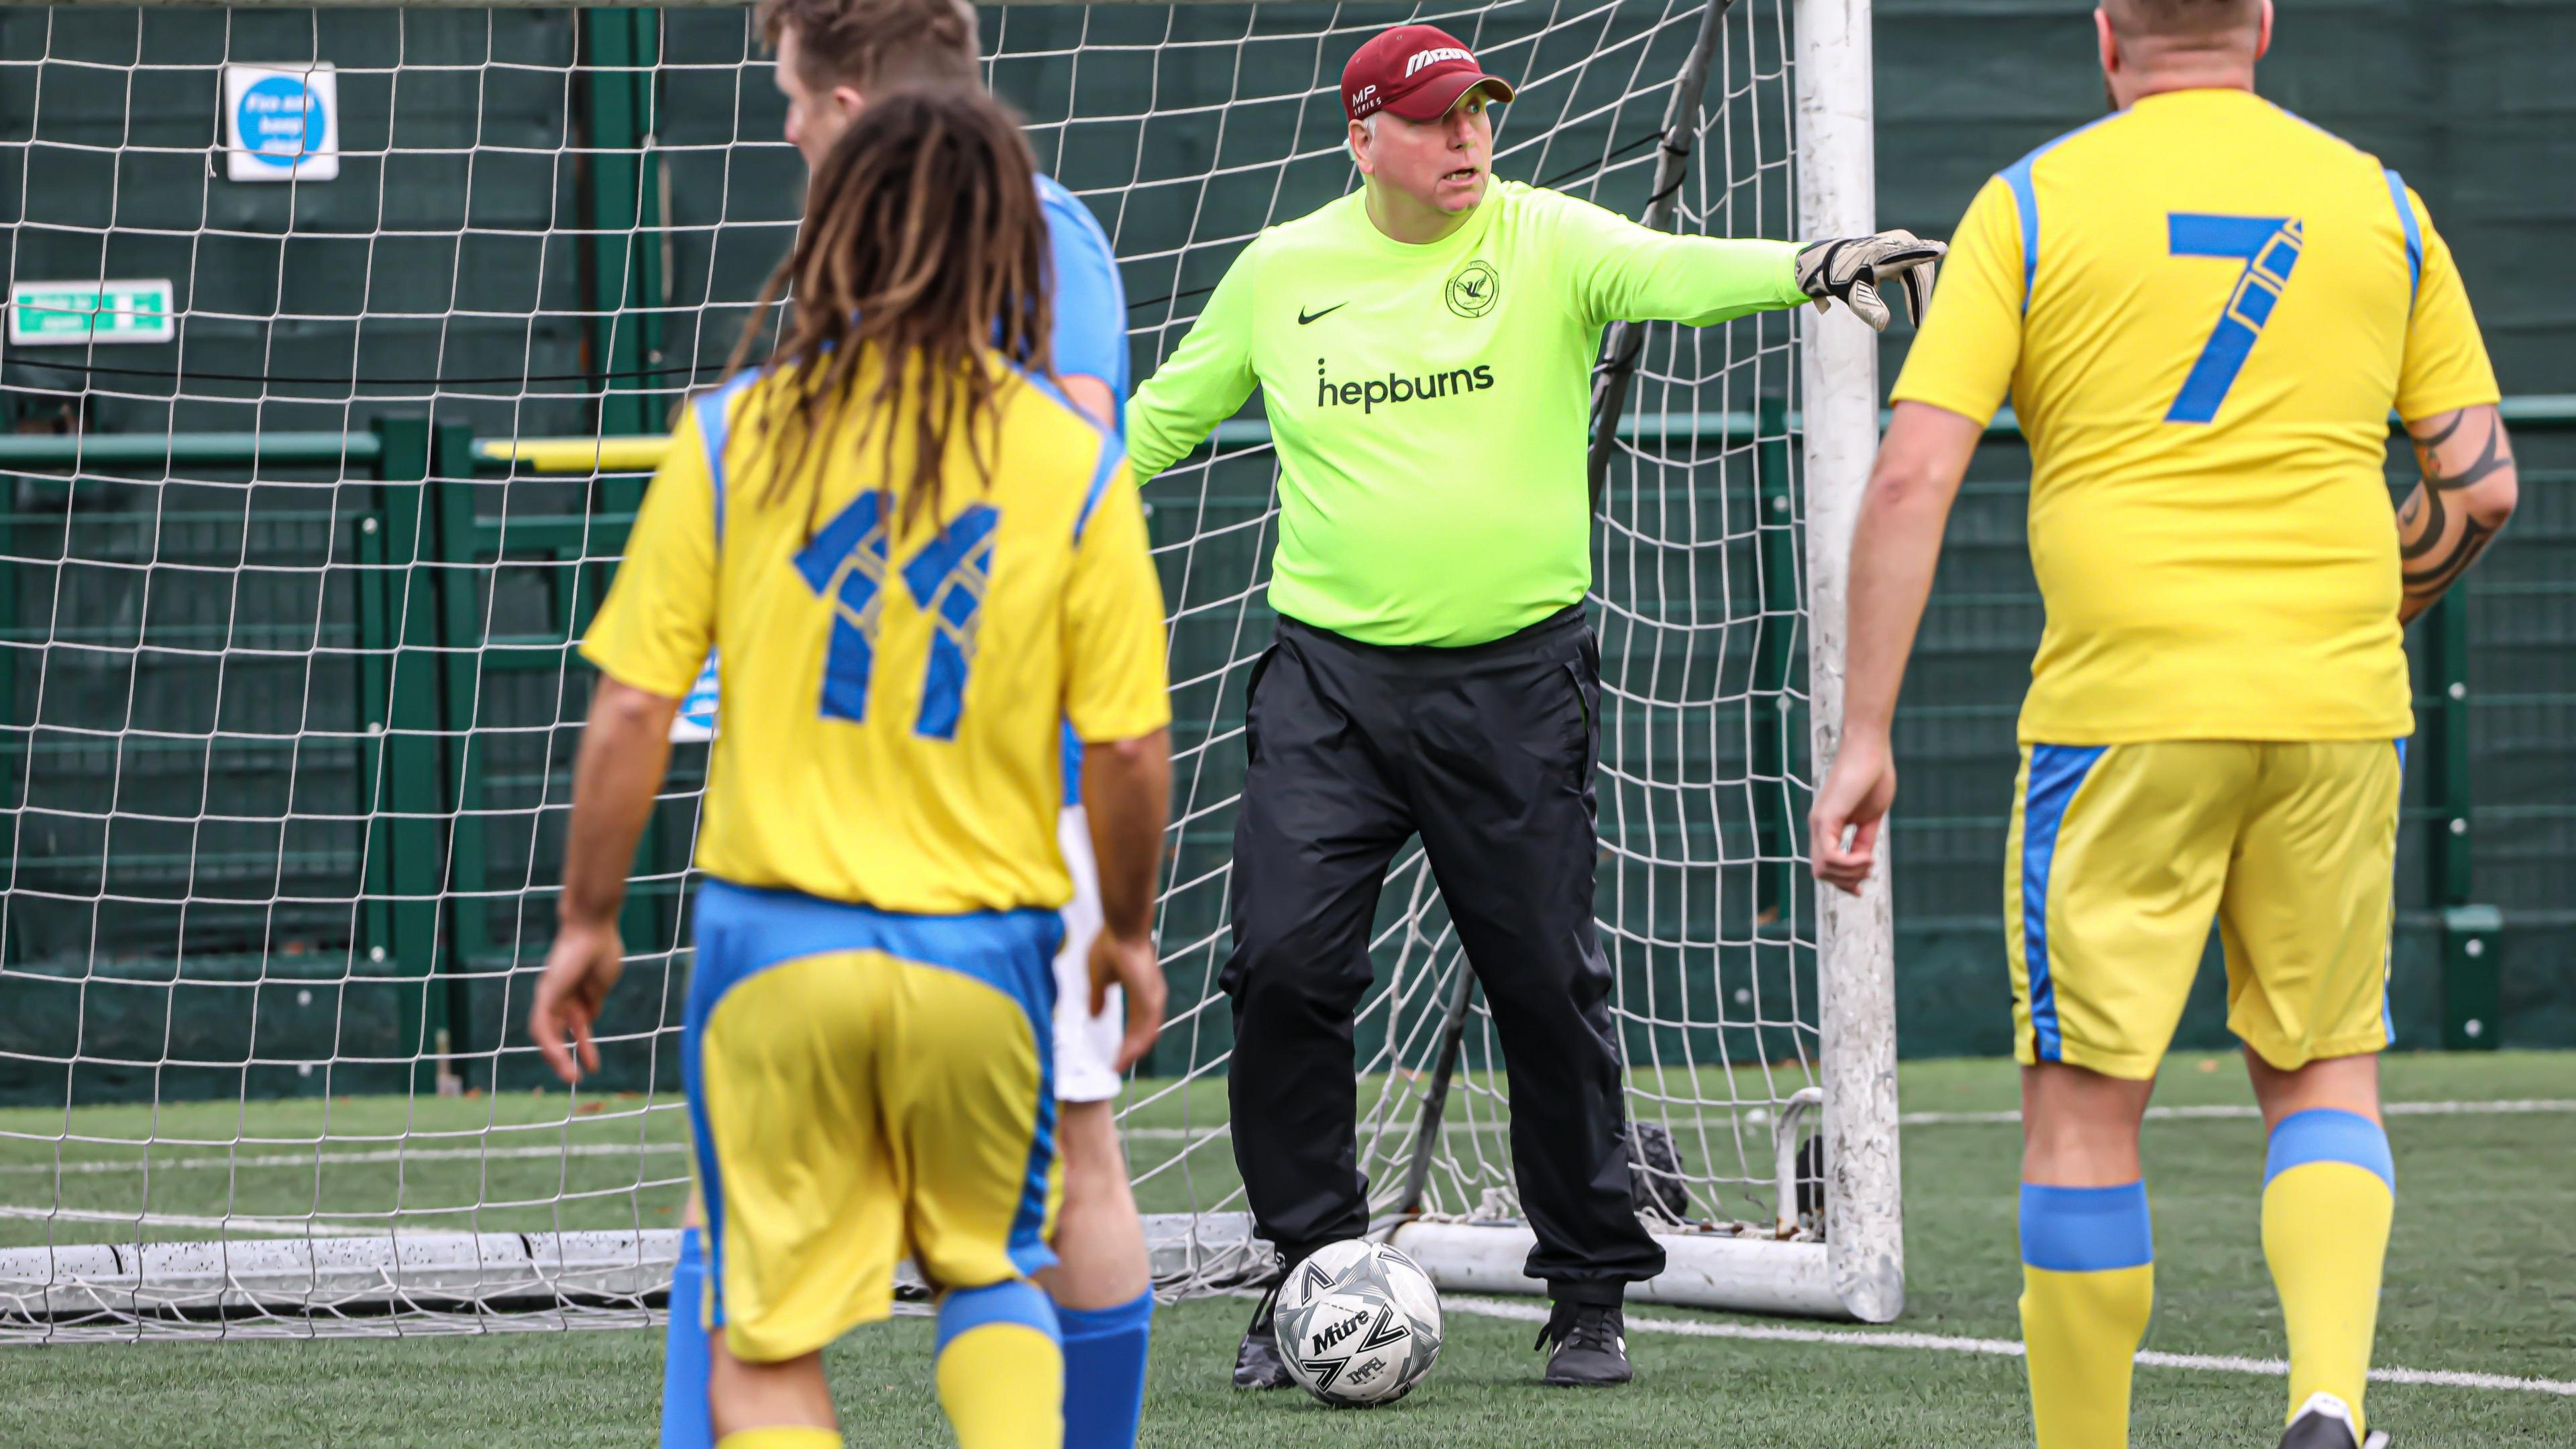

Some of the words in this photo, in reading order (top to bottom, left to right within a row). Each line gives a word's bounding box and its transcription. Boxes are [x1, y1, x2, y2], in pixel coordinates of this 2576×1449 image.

[1352, 85, 1376, 107] MP
[1354, 97, 1382, 116] SERIES
[2162, 213, 2302, 424] 7
[1318, 358, 1495, 415] hepburns
[792, 490, 998, 741] 11
[1311, 1310, 1369, 1356] Mitre
[1346, 1356, 1387, 1385] IMPEL
